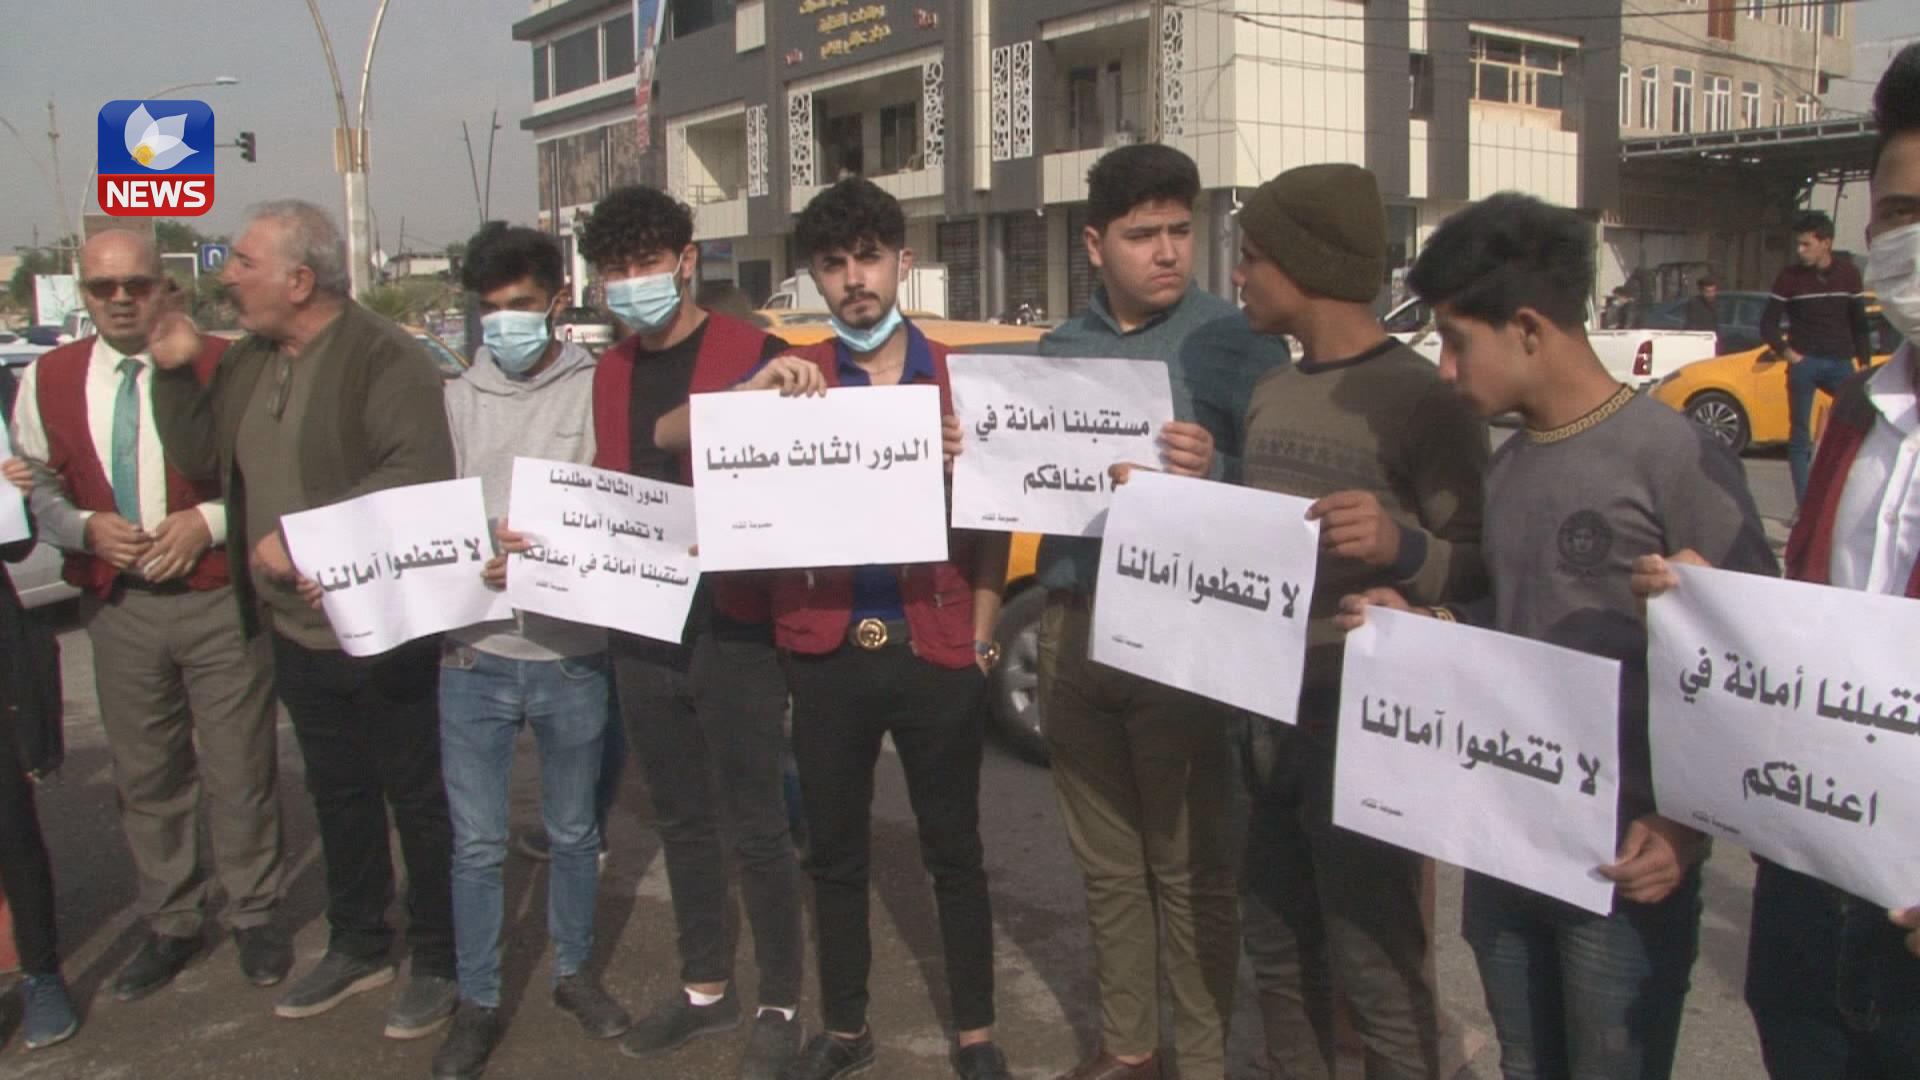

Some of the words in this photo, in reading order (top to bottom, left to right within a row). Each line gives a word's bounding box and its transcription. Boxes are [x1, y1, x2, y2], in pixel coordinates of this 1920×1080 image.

[975, 405, 998, 442] في
[1004, 404, 1056, 432] أمانة
[1062, 408, 1150, 444] مستقبلنا
[706, 442, 780, 479] مطلبنا
[787, 435, 861, 467] الثالث
[866, 436, 929, 470] الدور
[549, 468, 593, 492] مطلبنا
[595, 473, 634, 497] الثالث
[636, 489, 670, 506] الدور
[1023, 463, 1104, 495] اعناقكم
[607, 518, 651, 539] تقطعوا
[653, 526, 665, 542] لا
[385, 539, 458, 579] تقطعوا
[463, 536, 481, 562] لا
[578, 552, 597, 578] في
[1115, 543, 1182, 589] آمالنا
[315, 552, 383, 593] آمالنا
[1187, 559, 1271, 612] تقطعوا
[1280, 581, 1300, 619] لا
[1679, 646, 1713, 705] في
[1723, 651, 1805, 711] أمانة
[1360, 694, 1446, 749] آمالنا
[1456, 719, 1565, 785] تقطعوا
[1577, 752, 1601, 797] لا
[1741, 760, 1879, 827] اعناقكم
